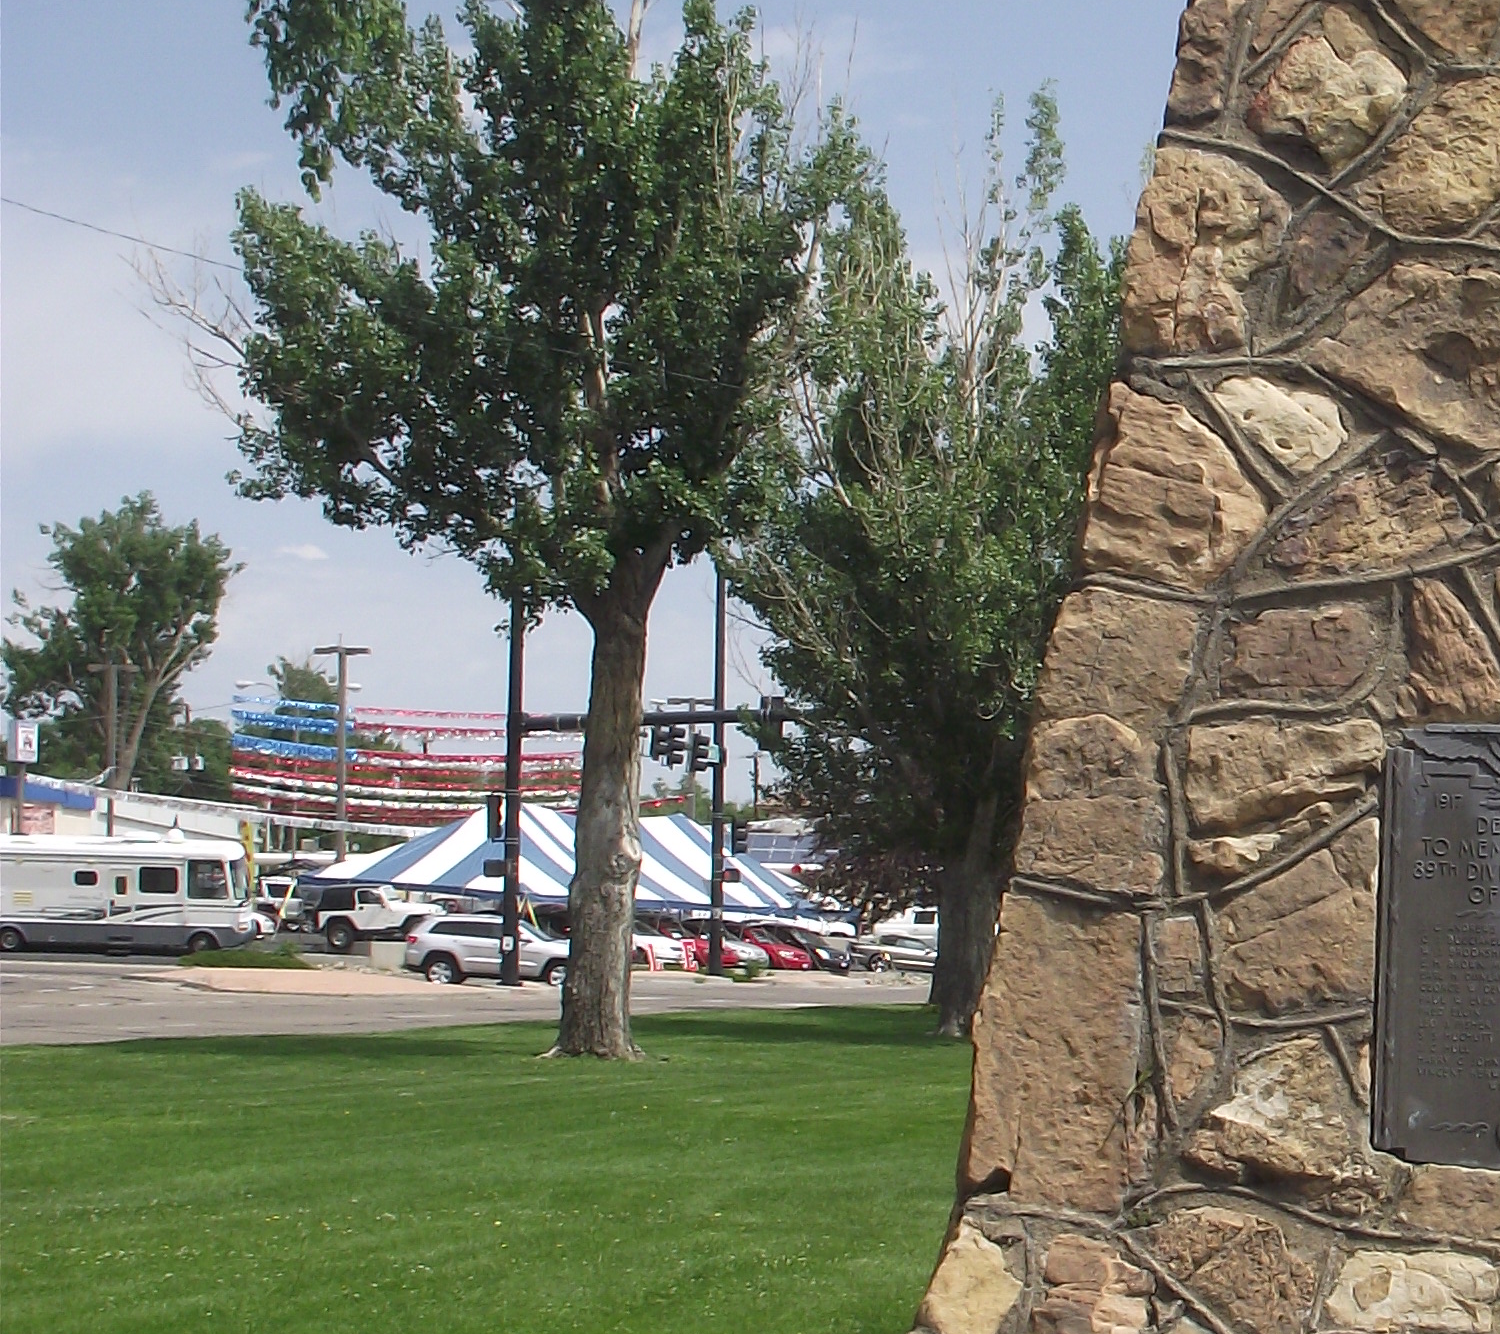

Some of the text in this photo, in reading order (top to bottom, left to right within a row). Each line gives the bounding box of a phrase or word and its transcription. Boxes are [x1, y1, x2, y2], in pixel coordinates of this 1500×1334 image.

[1434, 793, 1463, 810] 1917
[1421, 836, 1450, 856] TO
[1468, 885, 1499, 905] OF
